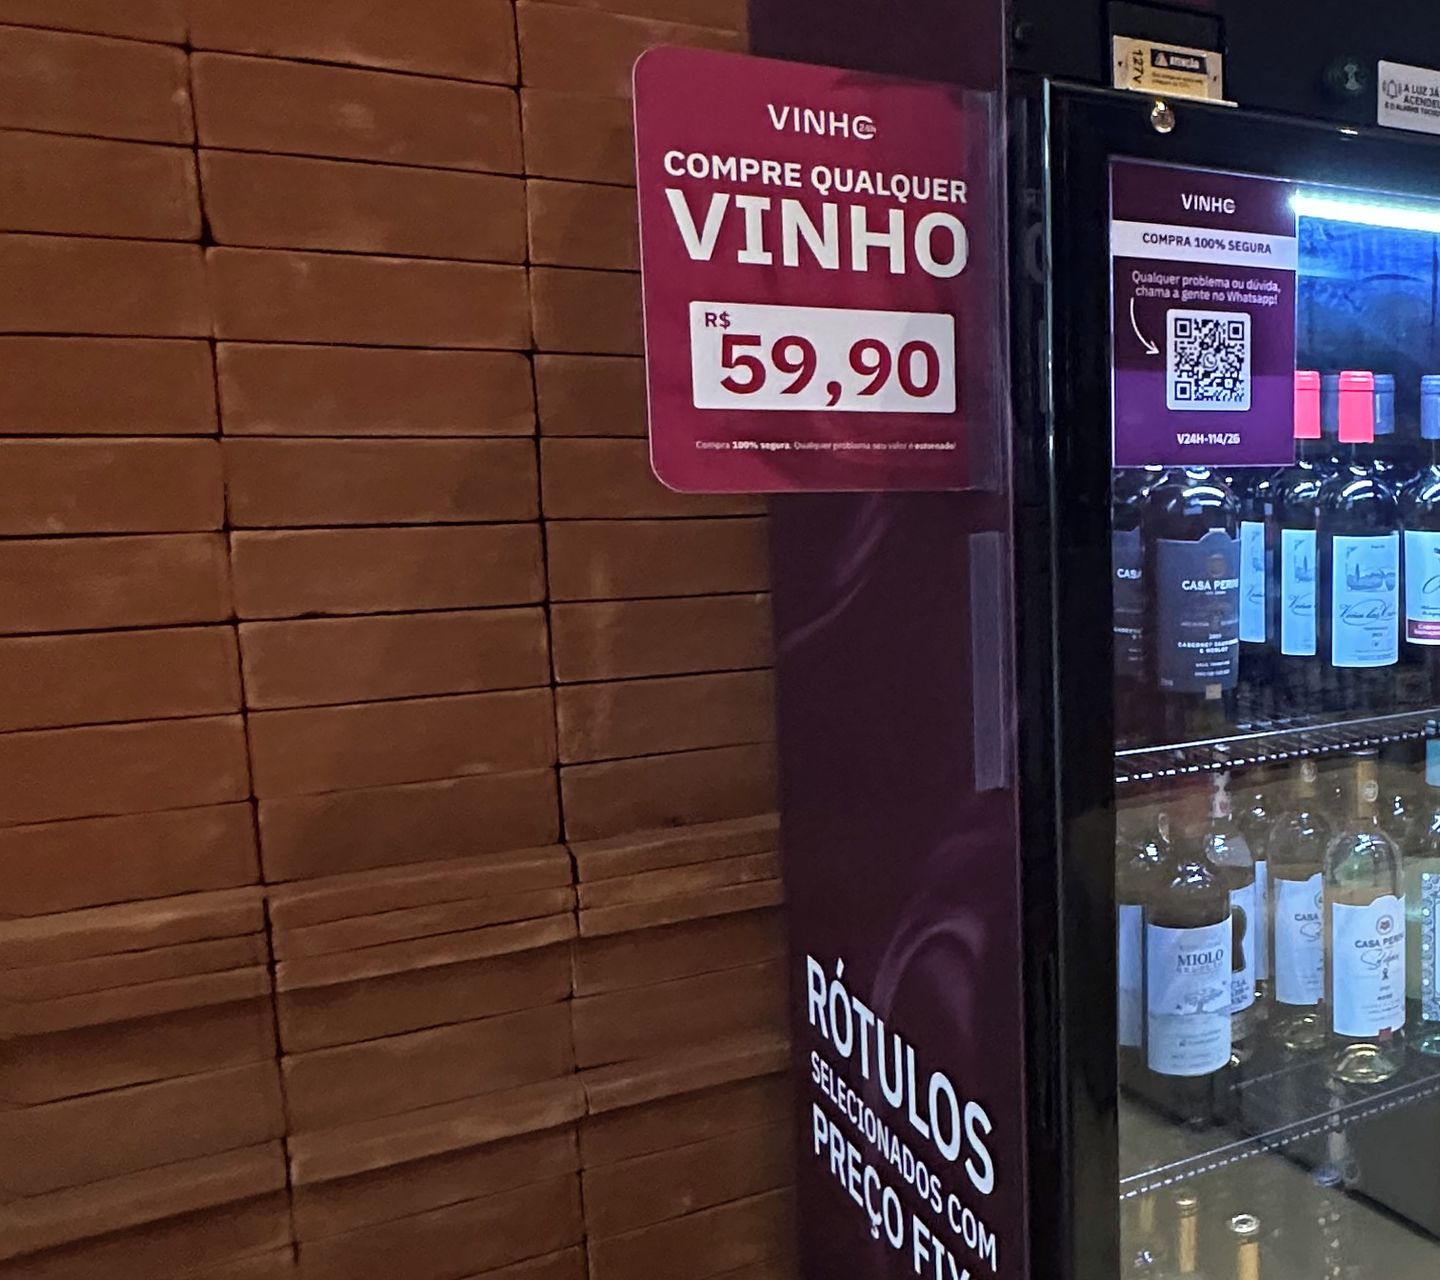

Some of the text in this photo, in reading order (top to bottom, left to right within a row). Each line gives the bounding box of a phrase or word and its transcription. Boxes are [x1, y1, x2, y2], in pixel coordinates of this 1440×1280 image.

[1404, 84, 1440, 97] A LUZ JÁ
[663, 151, 968, 204] COMPRE QUALQUER
[665, 189, 969, 279] VINHO
[1142, 233, 1272, 254] COMPRA 100% SEGURA
[1131, 270, 1281, 294] Qualquer problema ou dúvida,
[1135, 285, 1278, 306] chama a gente no Whatsapp!
[704, 312, 731, 329] R$
[720, 334, 940, 407] 59,90
[696, 440, 730, 451] Compra
[732, 440, 758, 450] 100%
[761, 442, 791, 452] segura.
[1182, 579, 1212, 591] CASA
[1294, 913, 1319, 922] CASA
[1354, 939, 1380, 949] CASA
[1177, 949, 1224, 967] MIOLO
[807, 954, 994, 1197] RÓTULOS
[811, 1051, 997, 1273] SELECIONADOS COM
[813, 1104, 904, 1251] PREÇO
